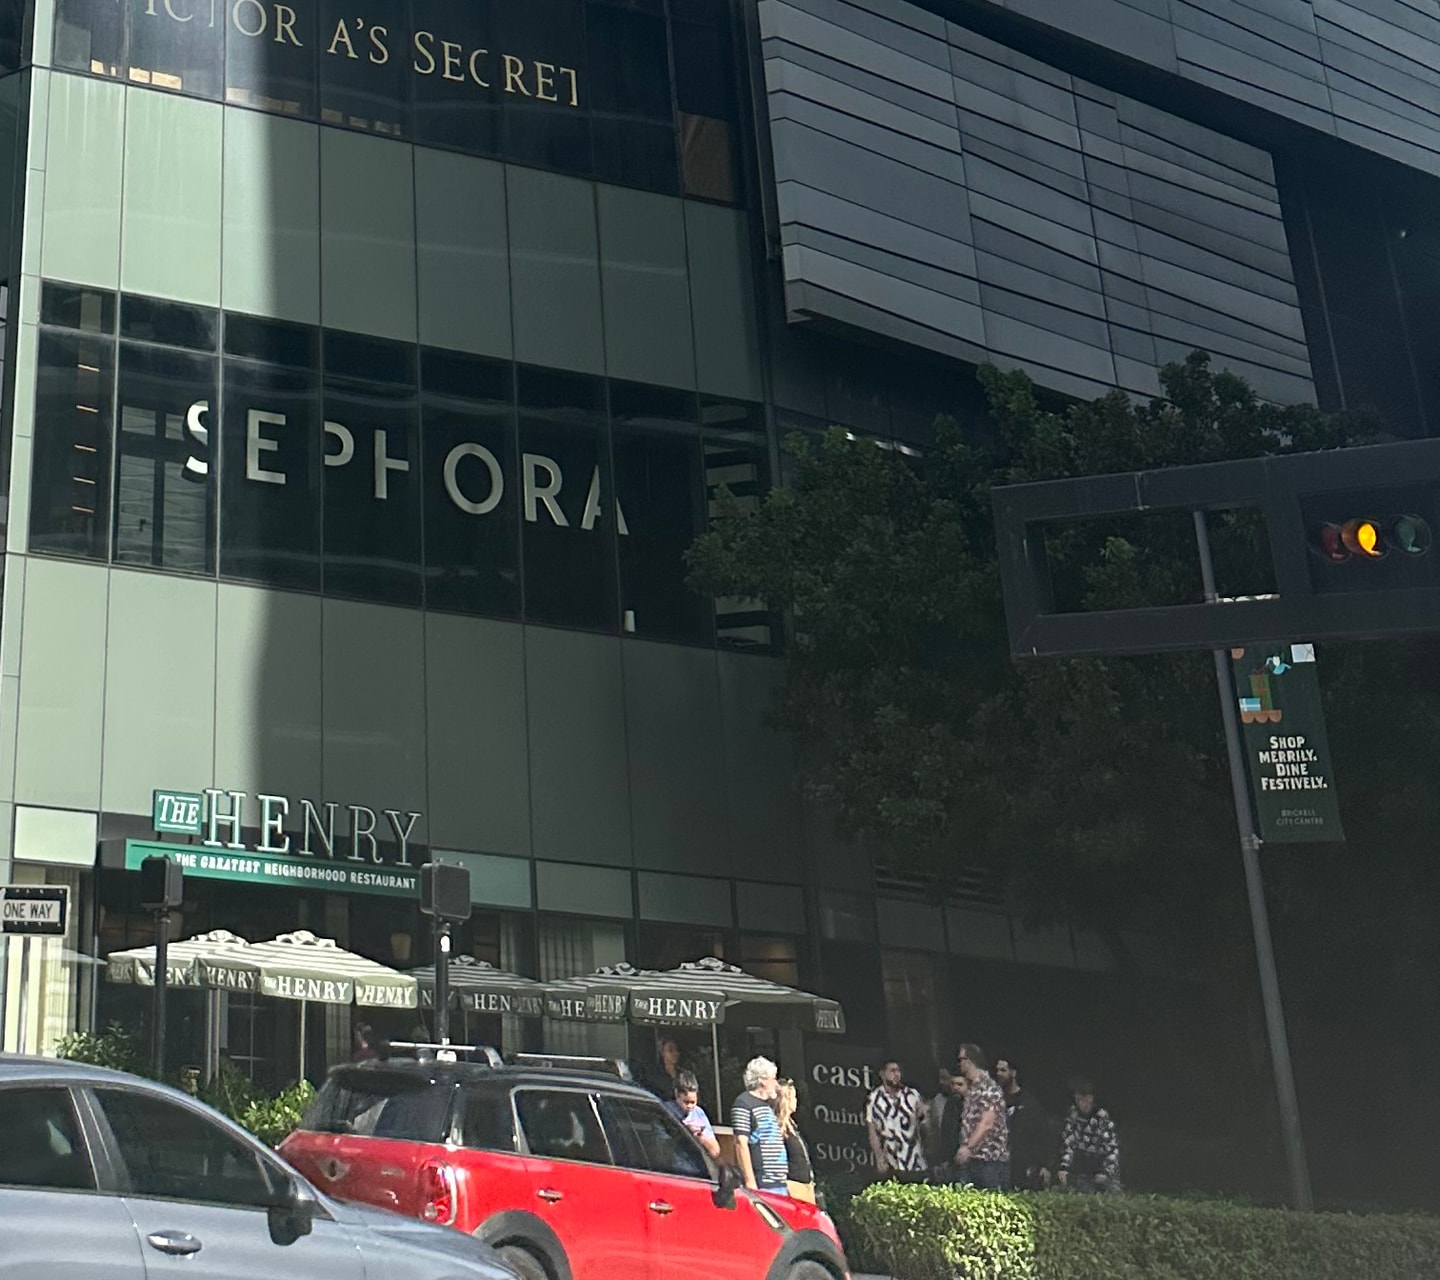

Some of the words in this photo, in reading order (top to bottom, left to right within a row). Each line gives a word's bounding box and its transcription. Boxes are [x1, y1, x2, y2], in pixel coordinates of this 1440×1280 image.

[183, 399, 629, 536] SEPHORA
[1269, 736, 1305, 749] SHOP
[1258, 748, 1318, 764] MERRILY.
[1275, 763, 1309, 777] DINE
[1260, 776, 1328, 791] FESTIVELY.
[158, 794, 201, 826] THE
[203, 788, 422, 867] HENRY
[175, 852, 197, 868] THE
[200, 853, 260, 875] GREATEST
[264, 862, 347, 884] NEIGHBORHOOD
[350, 871, 417, 890] RESTAURANT
[3, 902, 26, 919] ONE
[30, 902, 54, 919] WAY
[277, 975, 350, 1001] HENRY
[363, 984, 414, 1006] HENRY
[474, 993, 511, 1012] HEN
[648, 997, 721, 1020] HENRY
[812, 1063, 873, 1091] east
[813, 1104, 867, 1127] Quint
